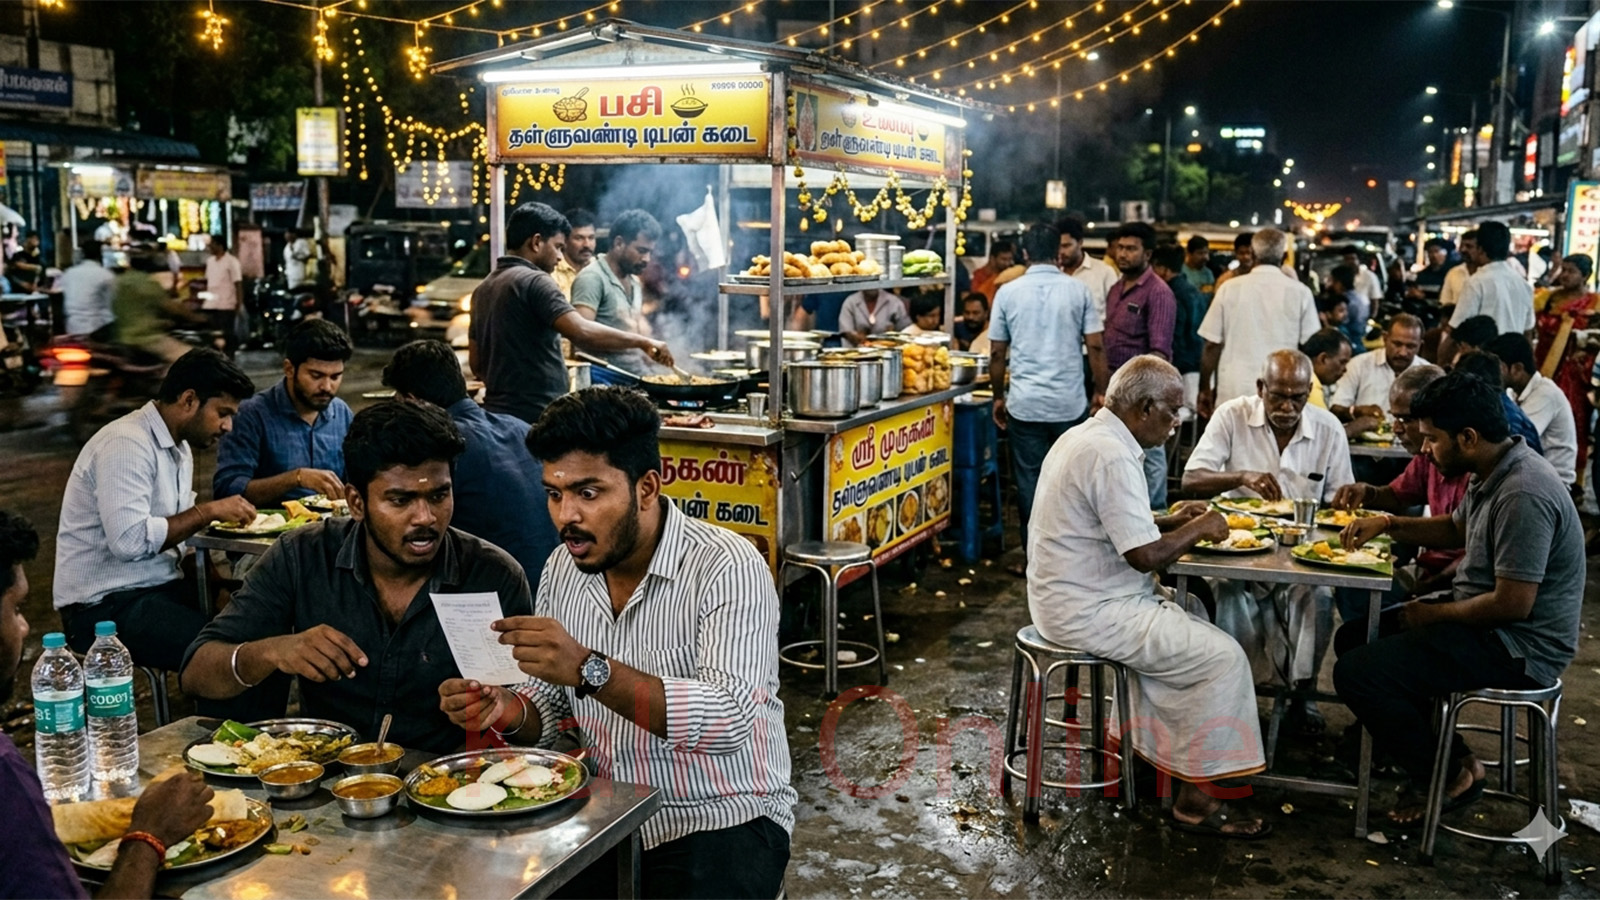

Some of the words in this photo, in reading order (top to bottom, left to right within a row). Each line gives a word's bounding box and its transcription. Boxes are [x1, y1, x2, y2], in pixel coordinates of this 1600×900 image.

[600, 86, 663, 116] பசி
[508, 123, 638, 149] தள்ளுவண்டி
[643, 121, 697, 149] டிபன்
[702, 125, 757, 144] கடை
[716, 502, 768, 526] கடை
